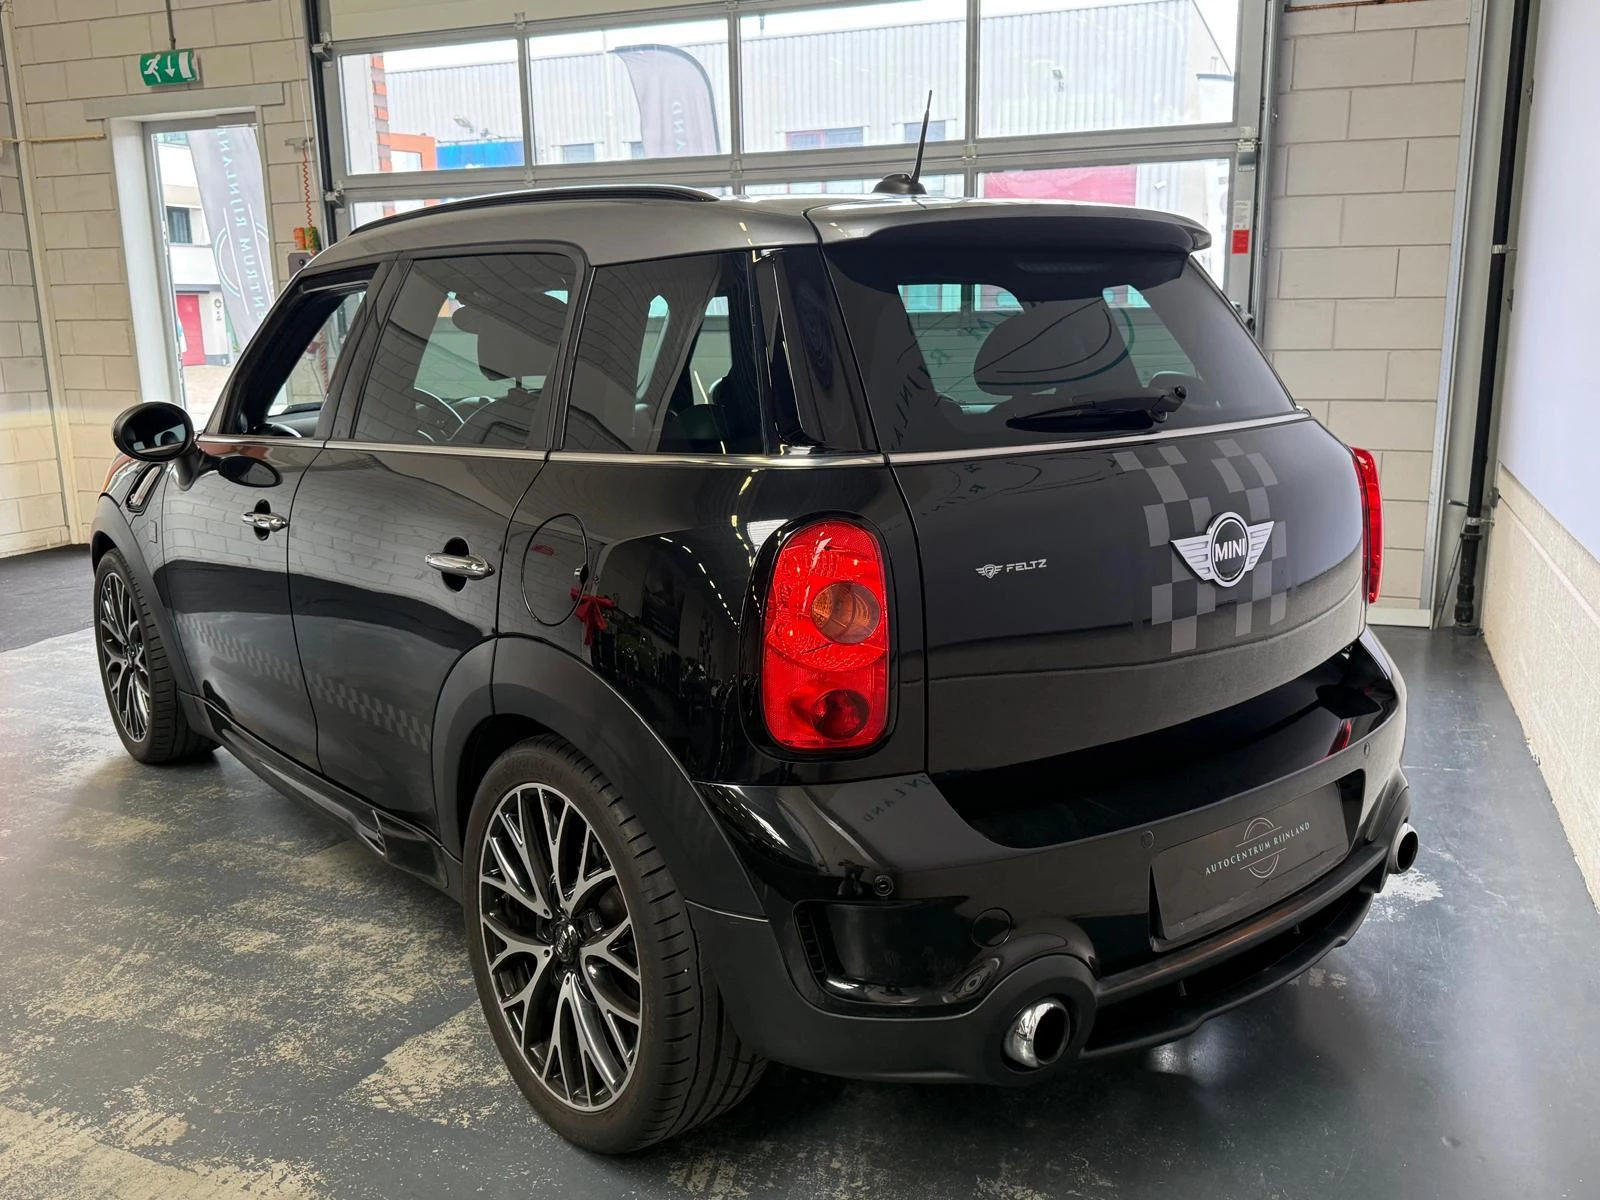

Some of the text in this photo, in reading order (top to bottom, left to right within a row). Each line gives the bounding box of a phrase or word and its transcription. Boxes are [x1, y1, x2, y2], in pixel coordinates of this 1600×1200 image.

[1214, 538, 1246, 562] MINI
[1006, 558, 1047, 573] FELTZ
[1205, 821, 1311, 876] AUTOCENTRUM RIJNLAND
